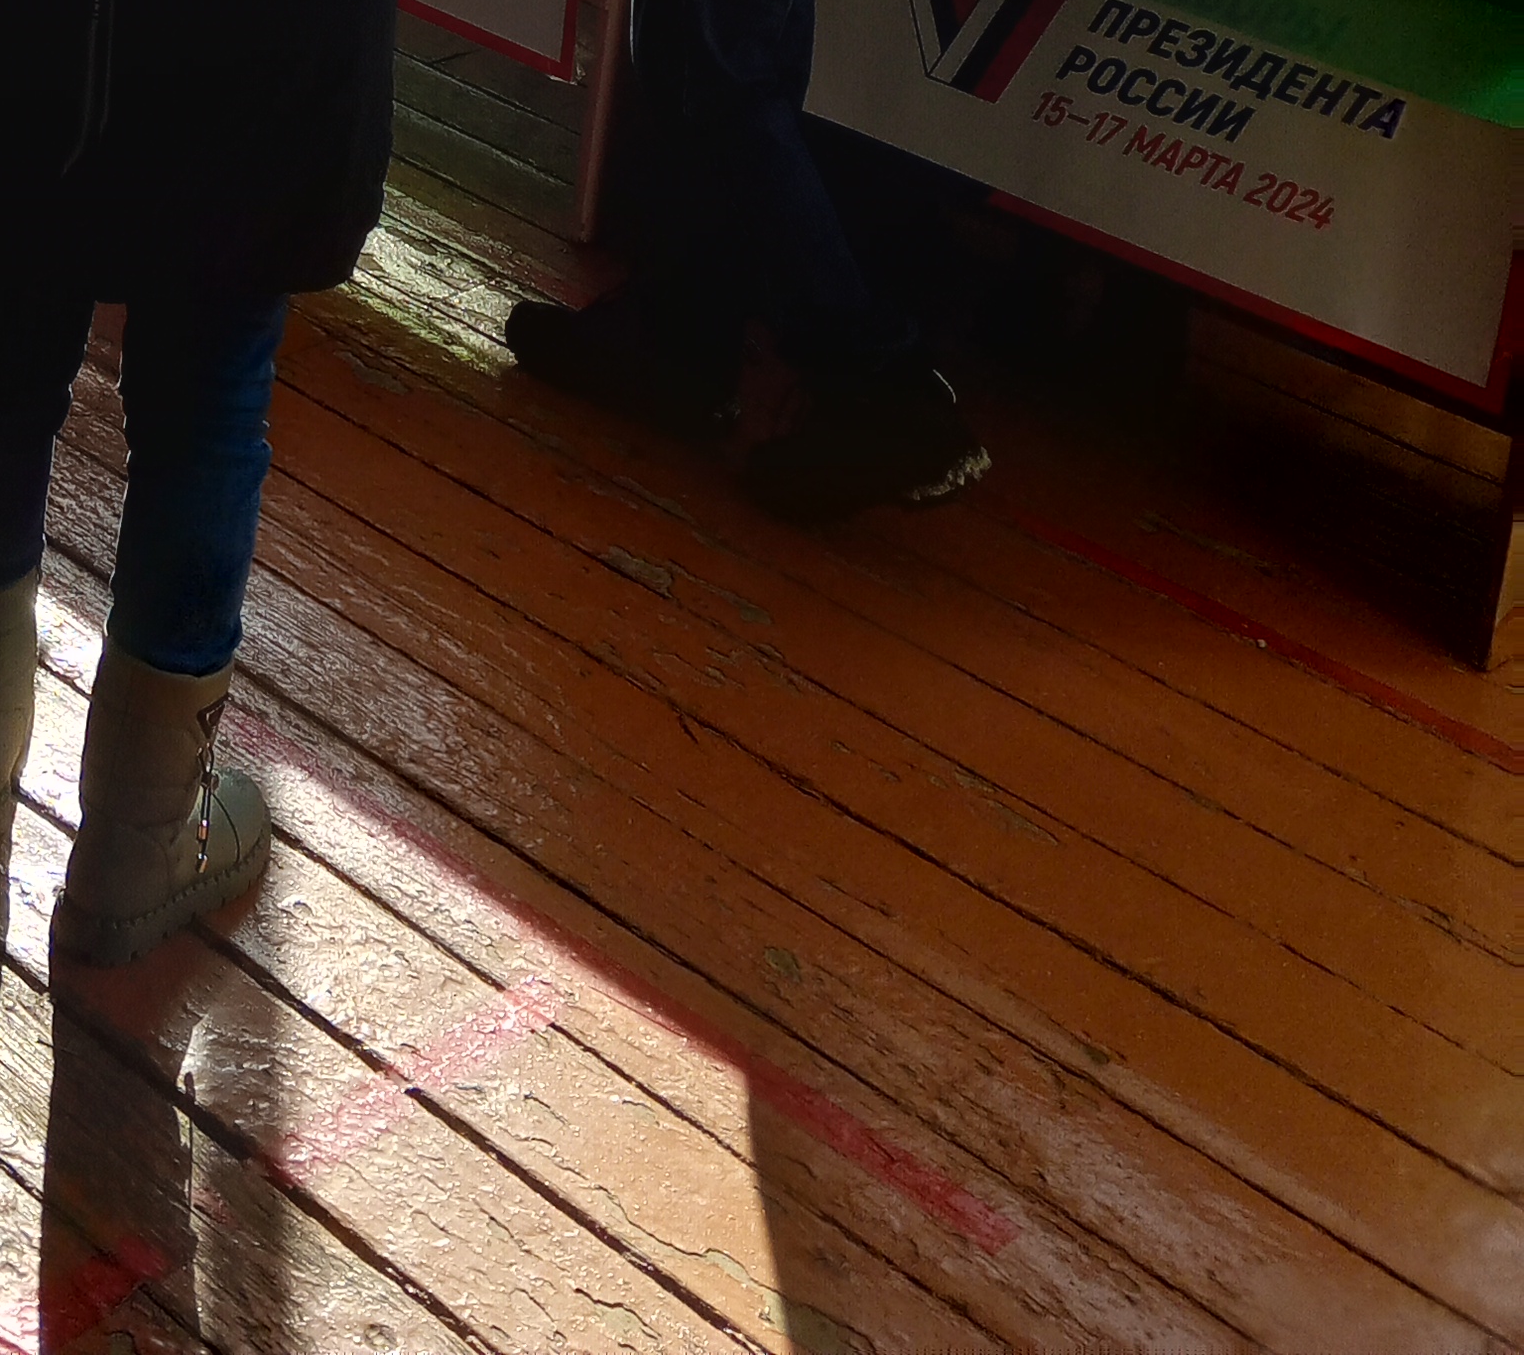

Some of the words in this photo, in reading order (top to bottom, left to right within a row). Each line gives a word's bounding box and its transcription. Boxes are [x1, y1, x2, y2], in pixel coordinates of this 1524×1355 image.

[1056, 42, 1257, 143] РОССИИ
[1123, 125, 1246, 197] МАРТА
[1243, 172, 1339, 230] 2024
